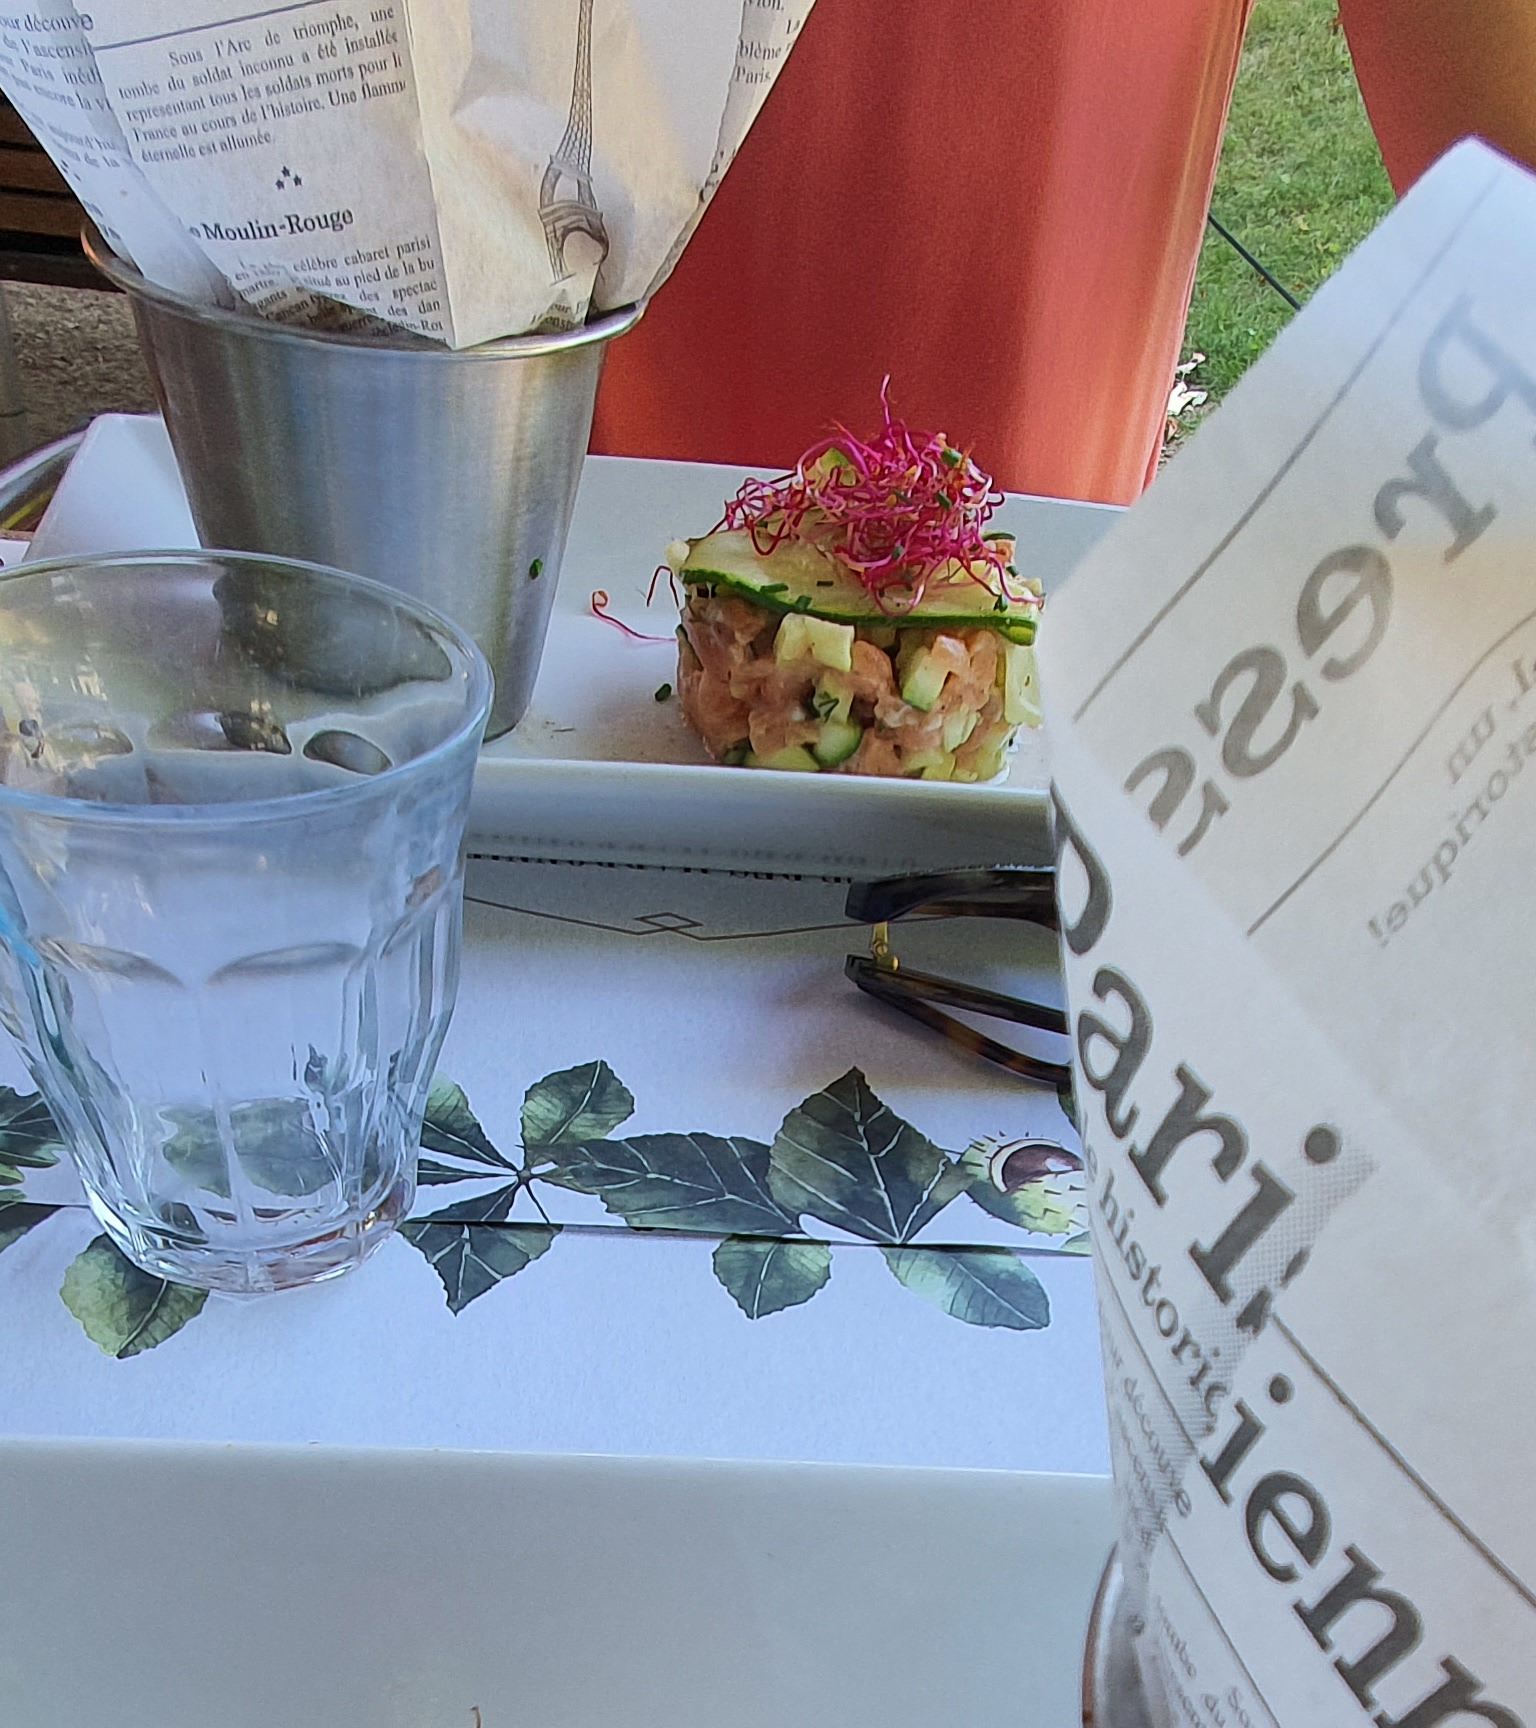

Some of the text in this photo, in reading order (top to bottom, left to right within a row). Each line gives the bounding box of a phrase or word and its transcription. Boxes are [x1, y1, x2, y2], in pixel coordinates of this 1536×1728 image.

[168, 50, 204, 67] Sous
[167, 75, 185, 91] du
[192, 66, 233, 86] soldat
[209, 92, 238, 107] tous
[202, 207, 356, 242] Moulin-Rouge
